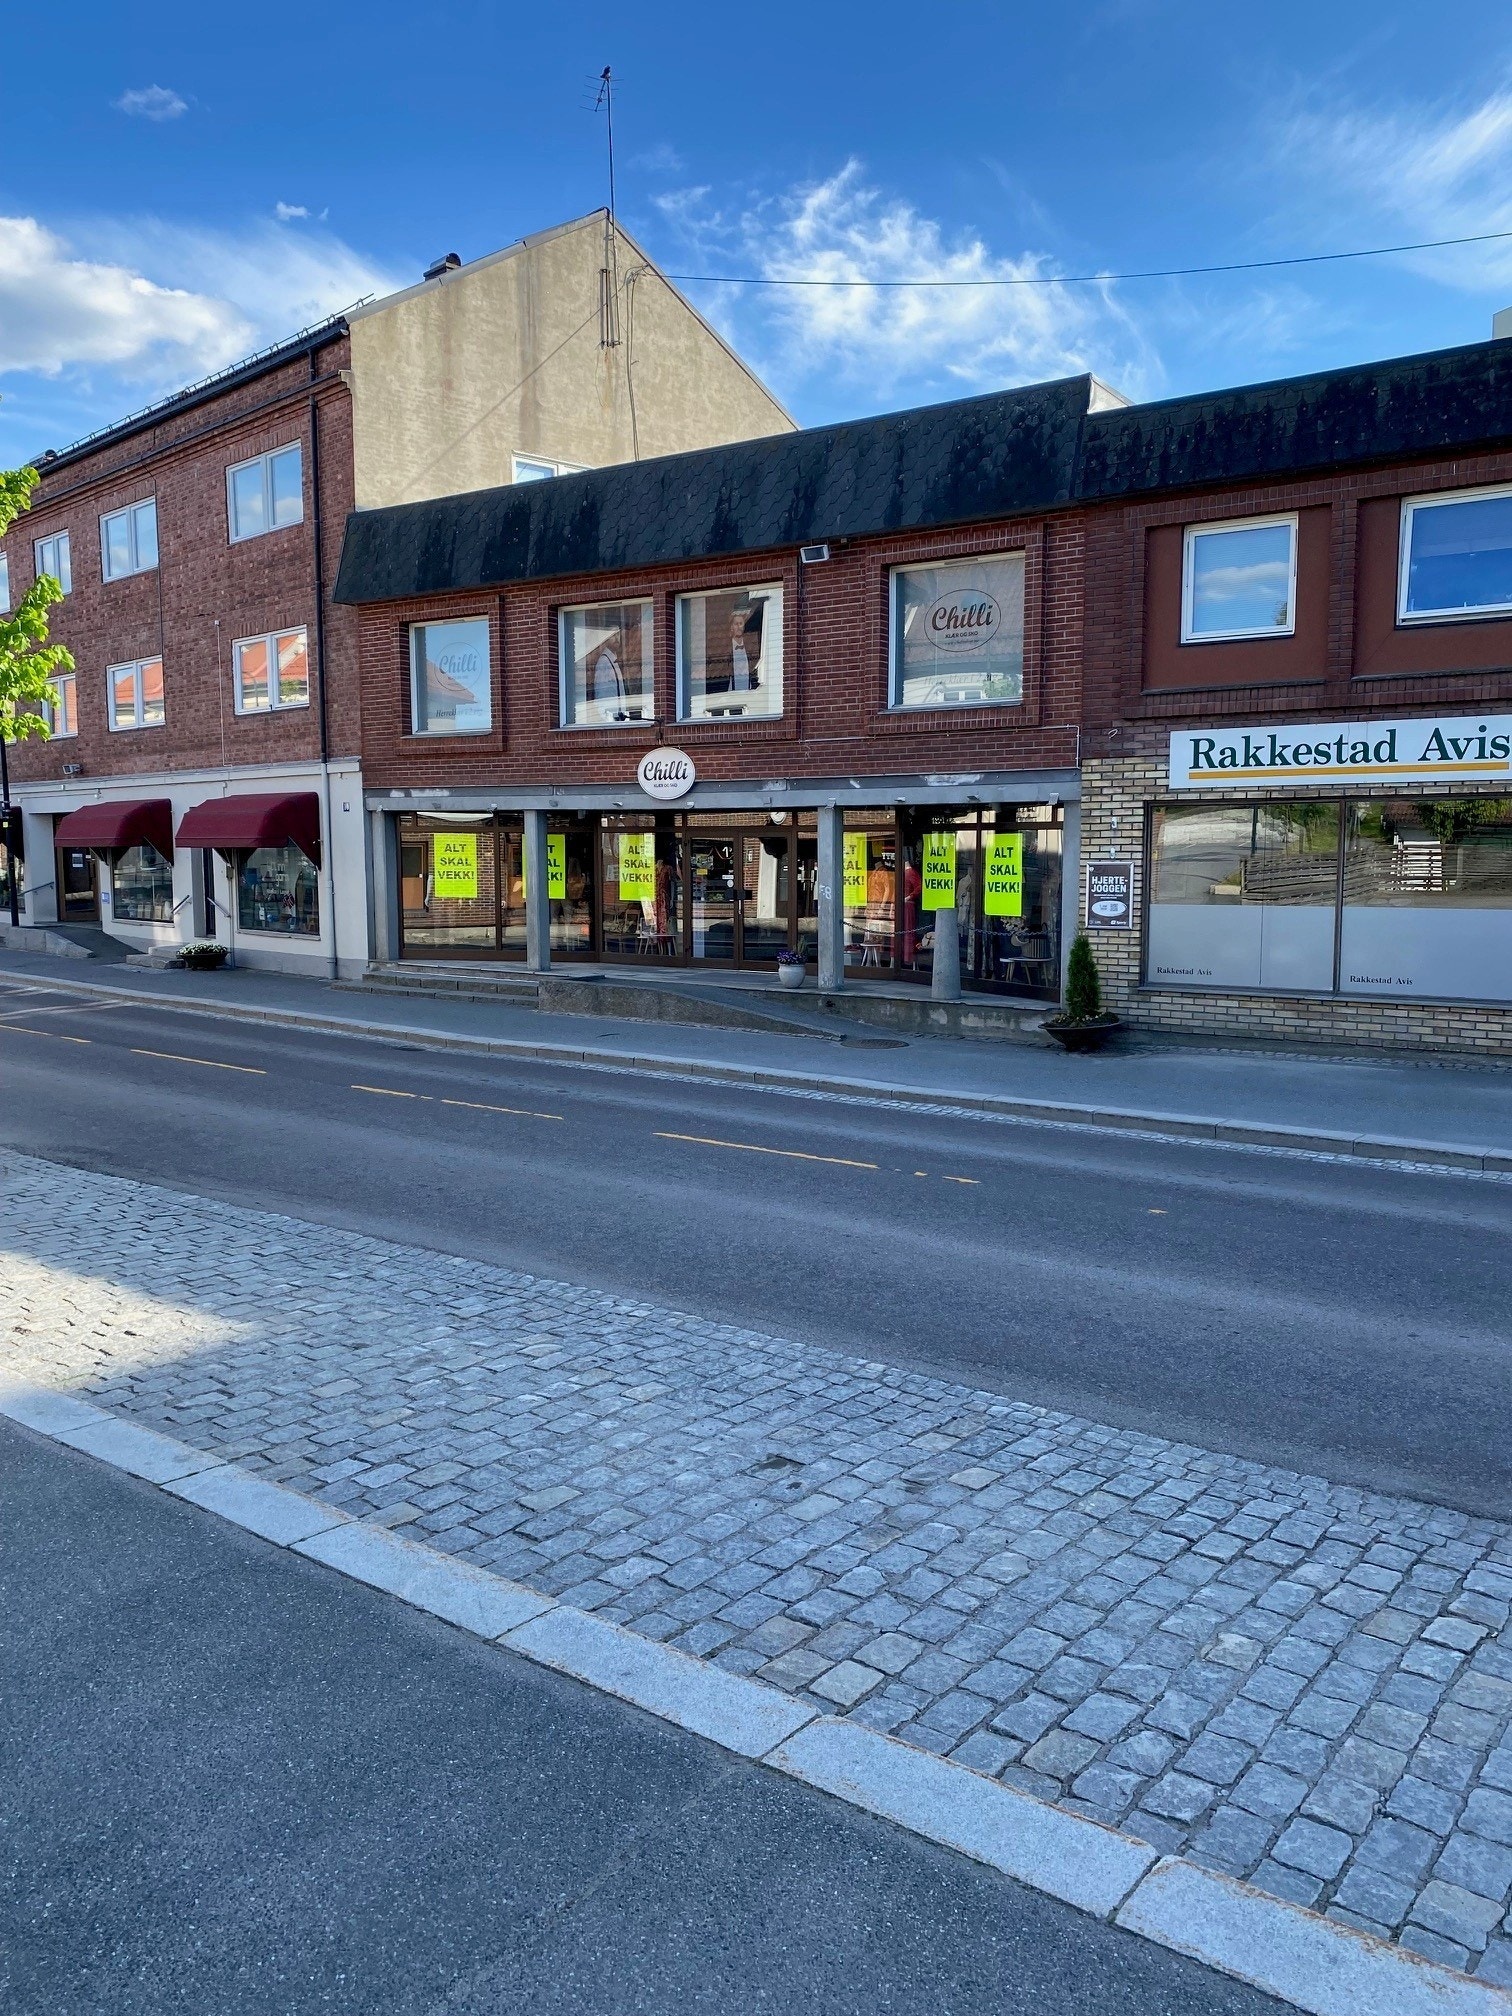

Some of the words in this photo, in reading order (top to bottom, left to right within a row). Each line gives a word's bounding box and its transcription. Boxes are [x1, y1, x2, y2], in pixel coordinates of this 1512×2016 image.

[932, 602, 993, 631] Chilli
[439, 653, 478, 675] Chilli
[1188, 729, 1398, 769] Rakkestad
[1418, 725, 1510, 761] Avis
[643, 760, 688, 781] Chilli
[444, 843, 467, 853] ALT
[930, 846, 947, 857] ALT
[994, 847, 1014, 858] ALT
[440, 856, 472, 867] SKAL
[547, 858, 560, 867] AL
[624, 859, 650, 869] SKAL
[926, 862, 951, 873] SKAL
[990, 864, 1018, 876] SKAL
[438, 870, 475, 880] VEKK!
[622, 872, 653, 883] VEKK!
[843, 875, 865, 885] KK!
[1091, 876, 1128, 884] HJERTE-
[925, 878, 954, 889] VEKK!
[987, 881, 1020, 893] VEKK!
[1091, 884, 1127, 893] JOGGEN
[1157, 966, 1194, 976] Rakkestad
[1197, 968, 1212, 976] Avis
[1350, 975, 1392, 985] Rakkestad
[1396, 976, 1413, 986] Avis
